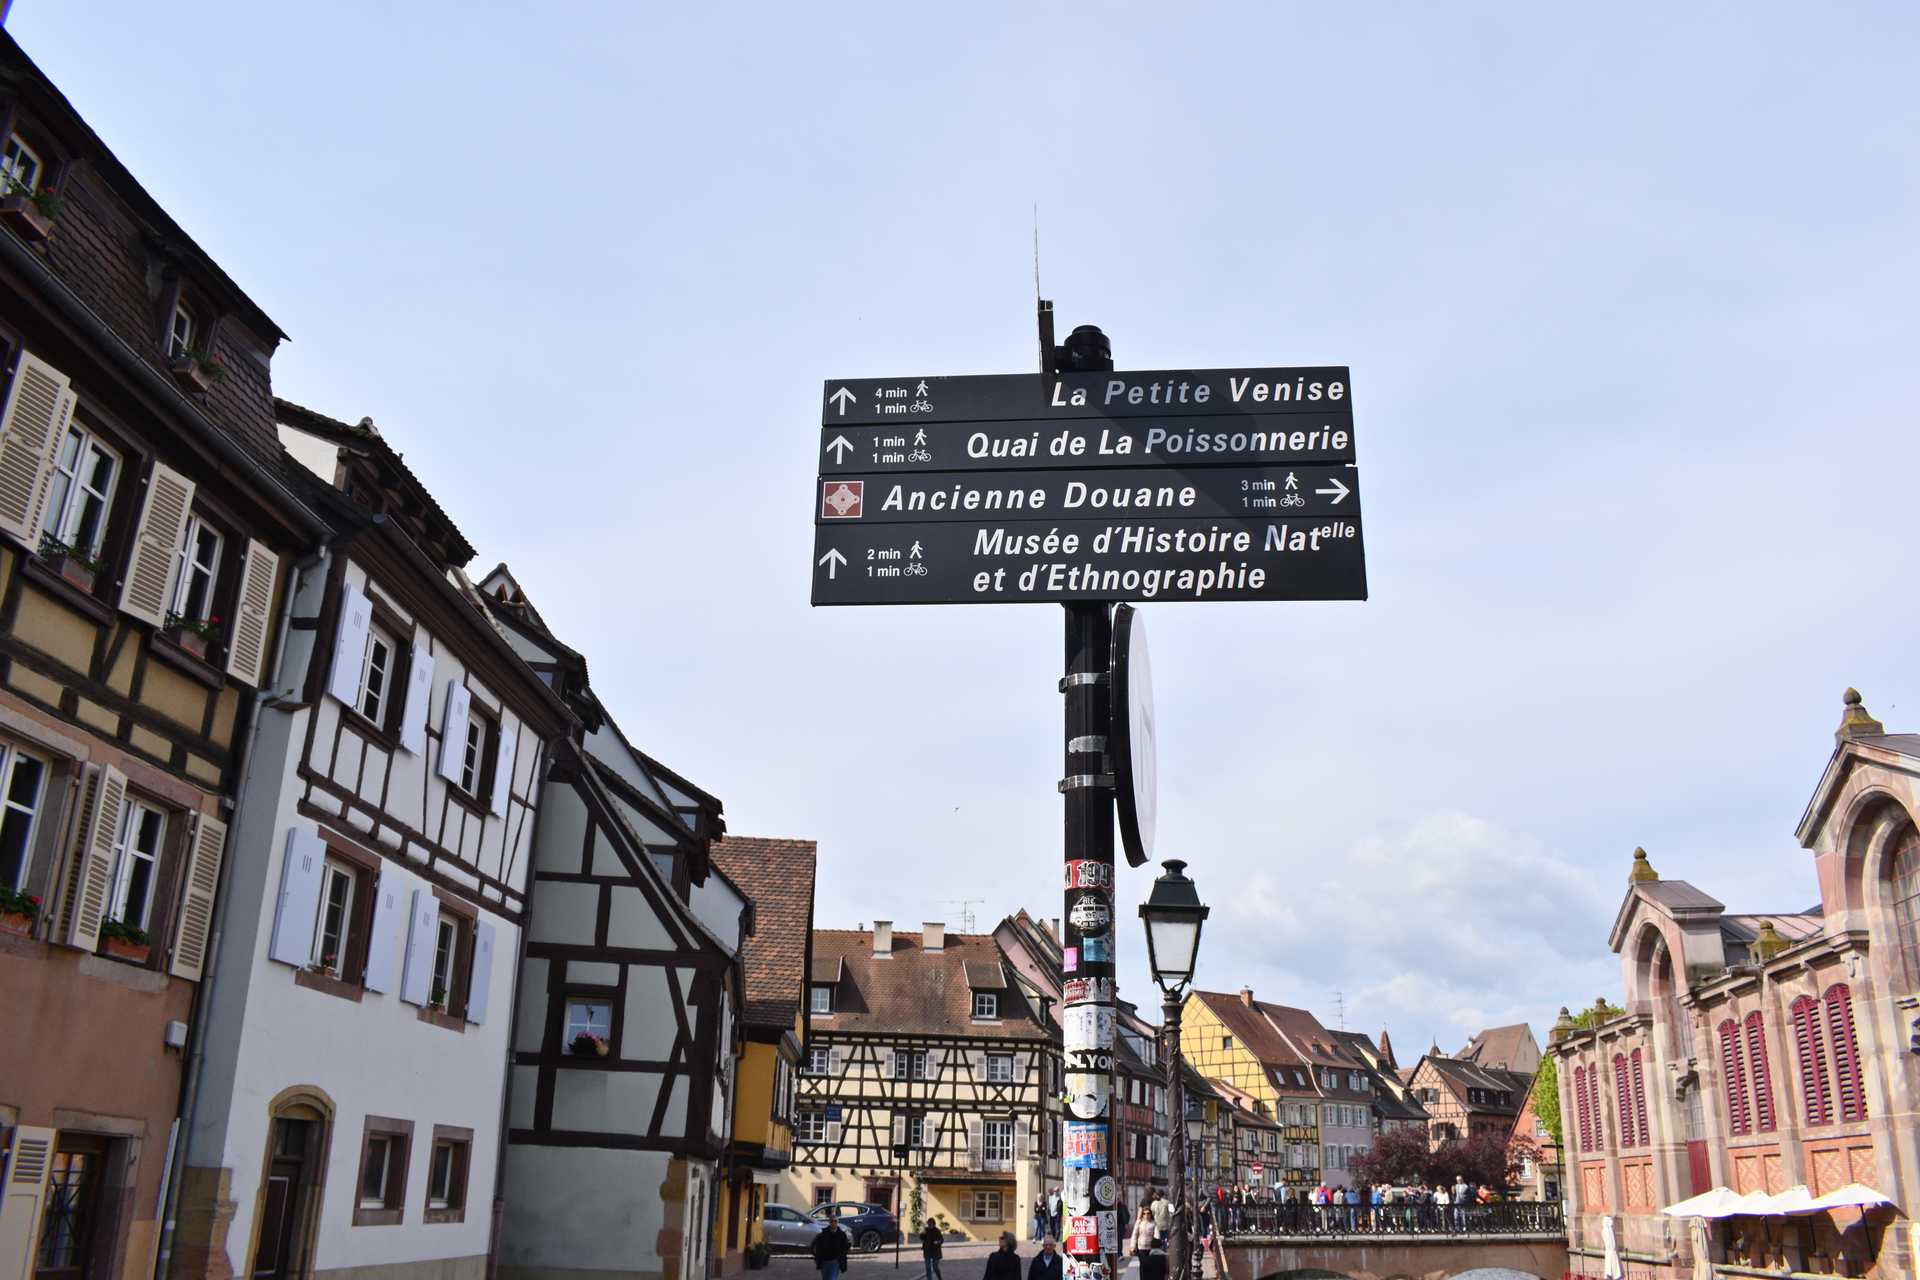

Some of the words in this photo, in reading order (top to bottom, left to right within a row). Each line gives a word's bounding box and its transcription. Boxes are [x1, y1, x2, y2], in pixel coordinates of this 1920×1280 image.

[875, 387, 883, 399] 4
[885, 387, 908, 398] min
[1051, 381, 1087, 407] La
[1104, 379, 1211, 405] Petite
[1229, 376, 1345, 403] Venise
[874, 403, 881, 414] 1
[884, 402, 907, 413] min
[872, 437, 879, 447] 1
[882, 435, 906, 447] min
[966, 430, 1041, 459] Quai
[1048, 429, 1087, 457] de
[1098, 428, 1134, 456] La
[1144, 424, 1349, 454] Poissonnerie
[872, 453, 879, 463] 1
[882, 451, 905, 463] min
[1241, 480, 1249, 491] 3
[1251, 479, 1276, 490] min
[880, 483, 1046, 512] Ancienne
[1063, 481, 1197, 509] Douane
[1242, 496, 1248, 508] 1
[1252, 495, 1277, 507] min
[973, 527, 1080, 556] Musée
[866, 549, 876, 561] 2
[878, 547, 901, 560] min
[866, 566, 873, 577] 1
[876, 564, 900, 577] min
[972, 567, 1006, 593] et
